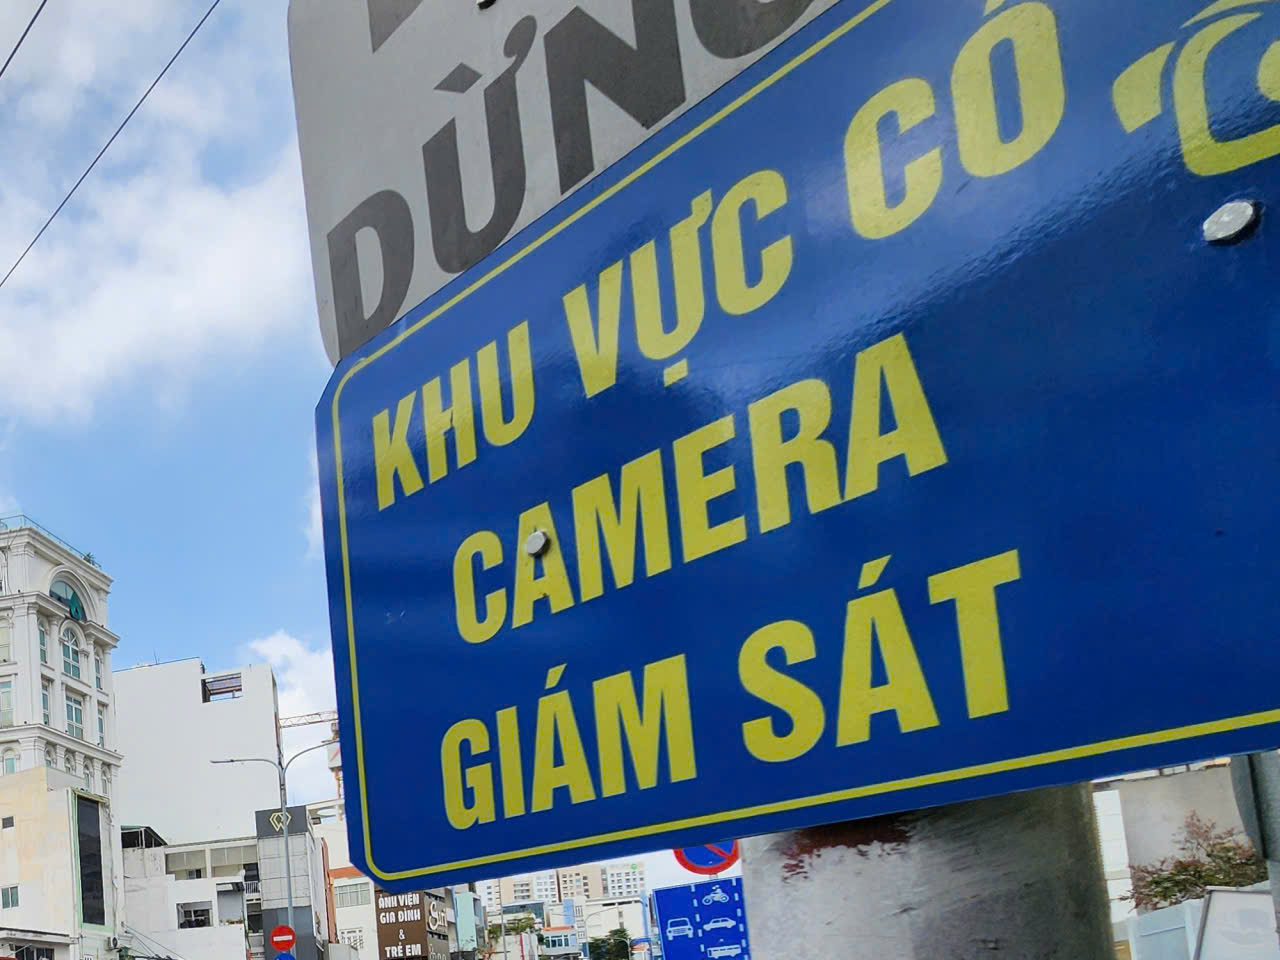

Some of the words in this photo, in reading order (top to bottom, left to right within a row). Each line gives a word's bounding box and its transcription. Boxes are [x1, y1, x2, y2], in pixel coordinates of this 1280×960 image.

[372, 320, 536, 512] KHU
[562, 170, 795, 399] VỰC
[842, 0, 1065, 241] CÓ
[451, 333, 950, 645] CAMERA
[439, 653, 697, 830] GIÁM
[737, 549, 1022, 763] SÁT
[380, 911, 396, 924] GIA
[398, 907, 421, 922] ĐÌNH
[384, 942, 403, 958] TRẺ
[406, 944, 422, 956] EM
[399, 929, 405, 940] &
